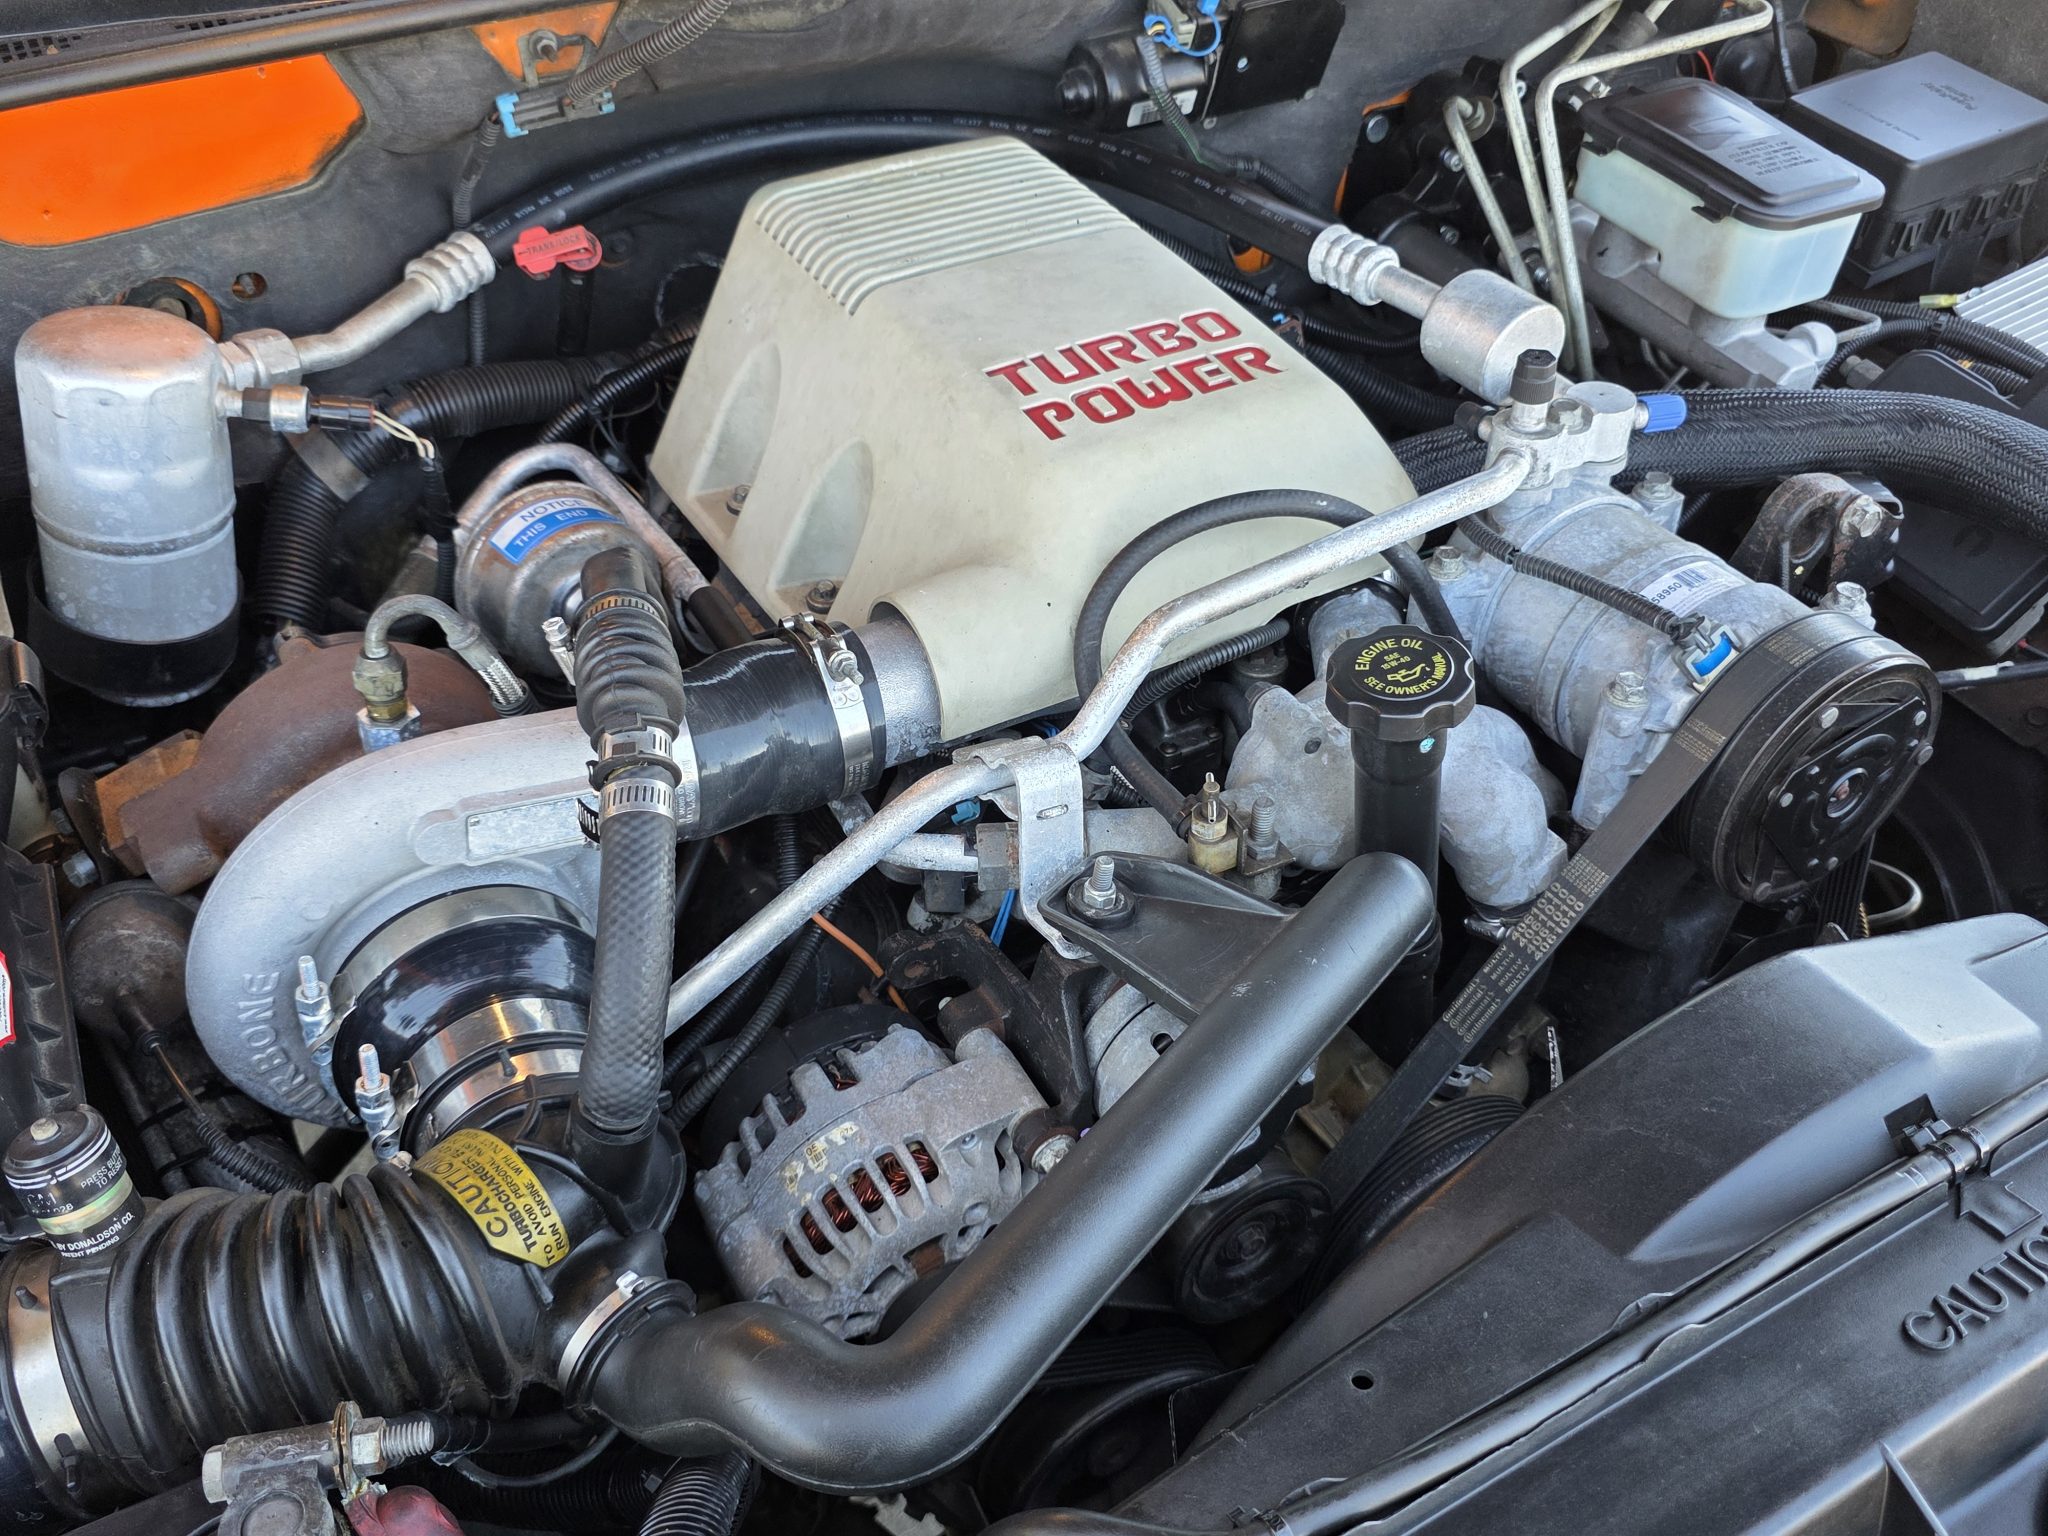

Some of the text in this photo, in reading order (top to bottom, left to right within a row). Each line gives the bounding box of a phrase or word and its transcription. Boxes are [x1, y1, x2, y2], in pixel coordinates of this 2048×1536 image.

[982, 308, 1242, 397] TURBO
[1020, 343, 1287, 440] POWER
[520, 499, 586, 522] NOTICE
[514, 522, 547, 547] THIS
[555, 510, 589, 521] END
[1355, 638, 1424, 671] ENGINE OIL
[1383, 652, 1400, 662] SAE
[1364, 676, 1386, 691] SEE
[1385, 679, 1438, 695] OWNER'S
[1511, 881, 1561, 941] 4061010
[1519, 888, 1569, 948] 4061010
[1526, 895, 1577, 955] 4061010
[1534, 901, 1585, 961] 4061010
[81, 1166, 108, 1189] PRESS
[96, 1177, 108, 1189] TO
[487, 1157, 523, 1199] PERSONAL
[462, 1156, 537, 1253] TURBOCHARGER
[501, 1154, 566, 1251] RUN ENGINE WITH
[523, 1203, 547, 1236] AVOID
[68, 1221, 122, 1251] DONALDSON
[86, 1235, 120, 1256] PENDING
[543, 1244, 556, 1264] TO
